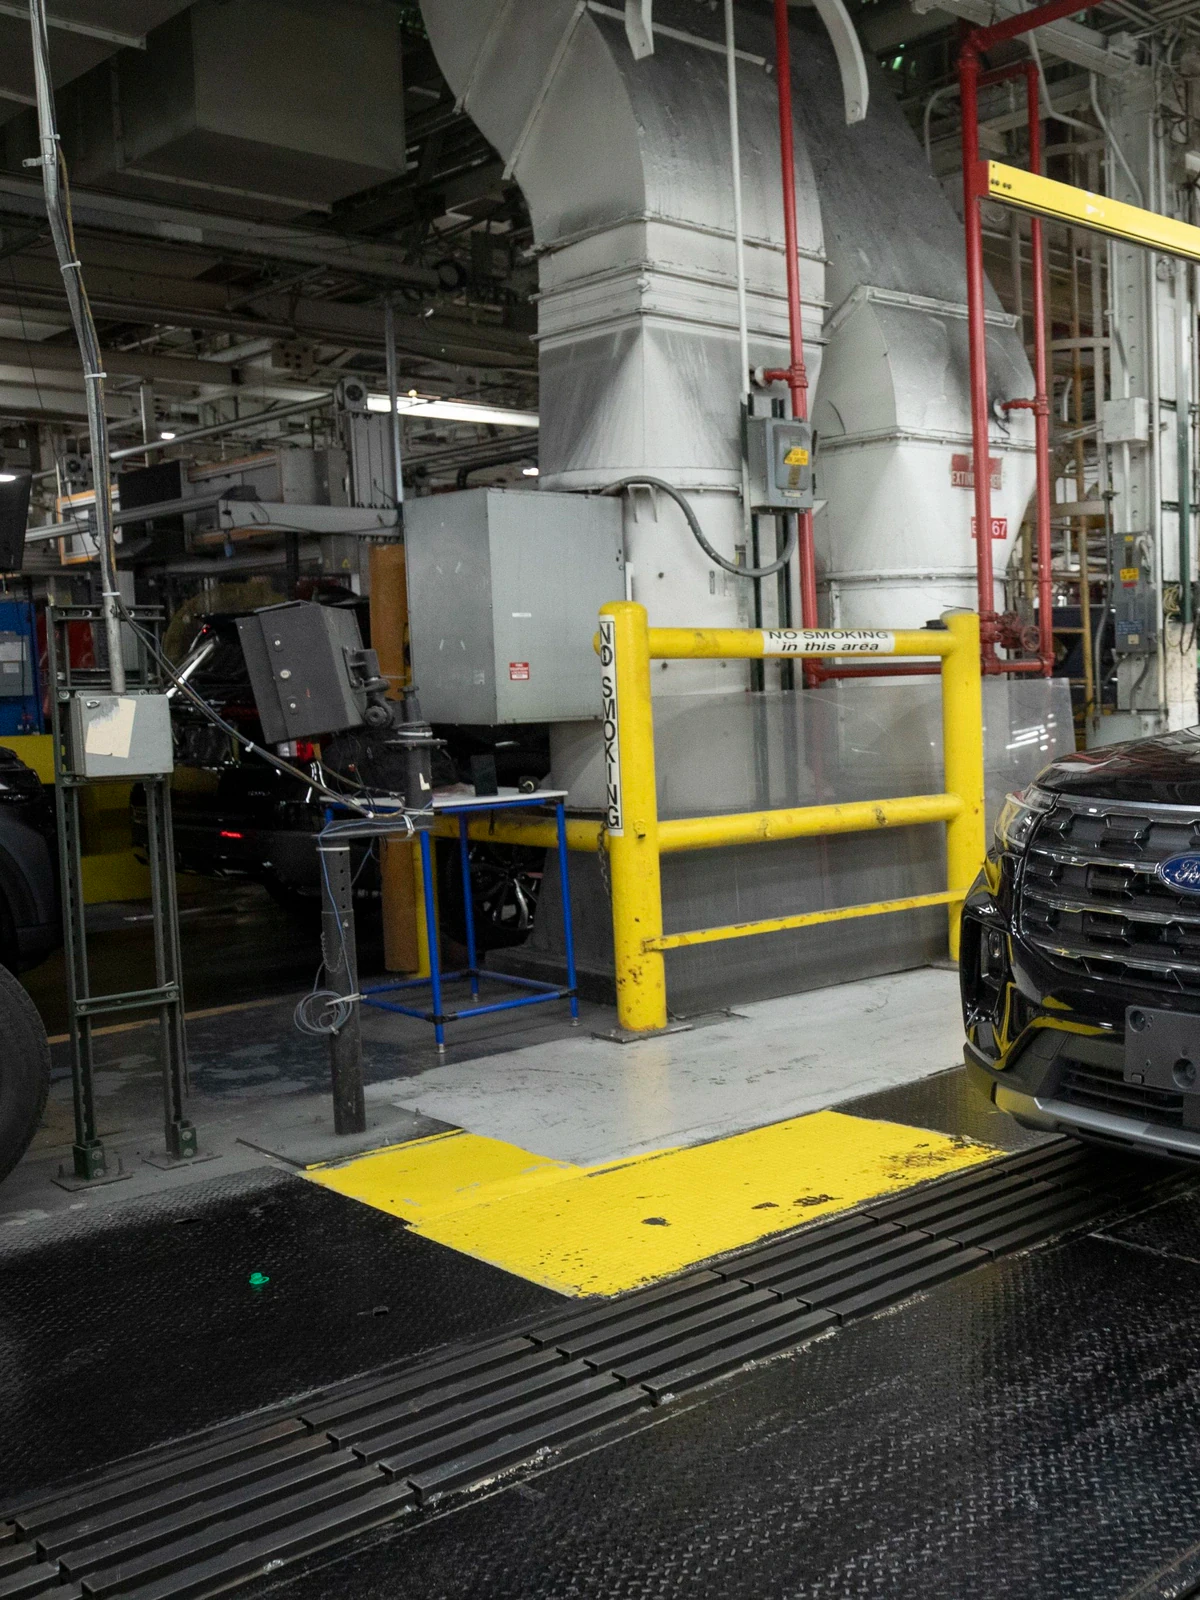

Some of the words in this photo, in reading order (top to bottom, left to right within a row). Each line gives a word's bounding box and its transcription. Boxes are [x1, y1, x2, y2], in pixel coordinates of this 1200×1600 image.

[992, 520, 1006, 535] 67
[769, 631, 798, 639] NO
[803, 631, 889, 639] SMOKING
[600, 623, 613, 667] NO
[781, 642, 798, 652] in
[804, 642, 836, 651] this
[841, 643, 879, 651] area
[602, 676, 619, 827] SMOKING
